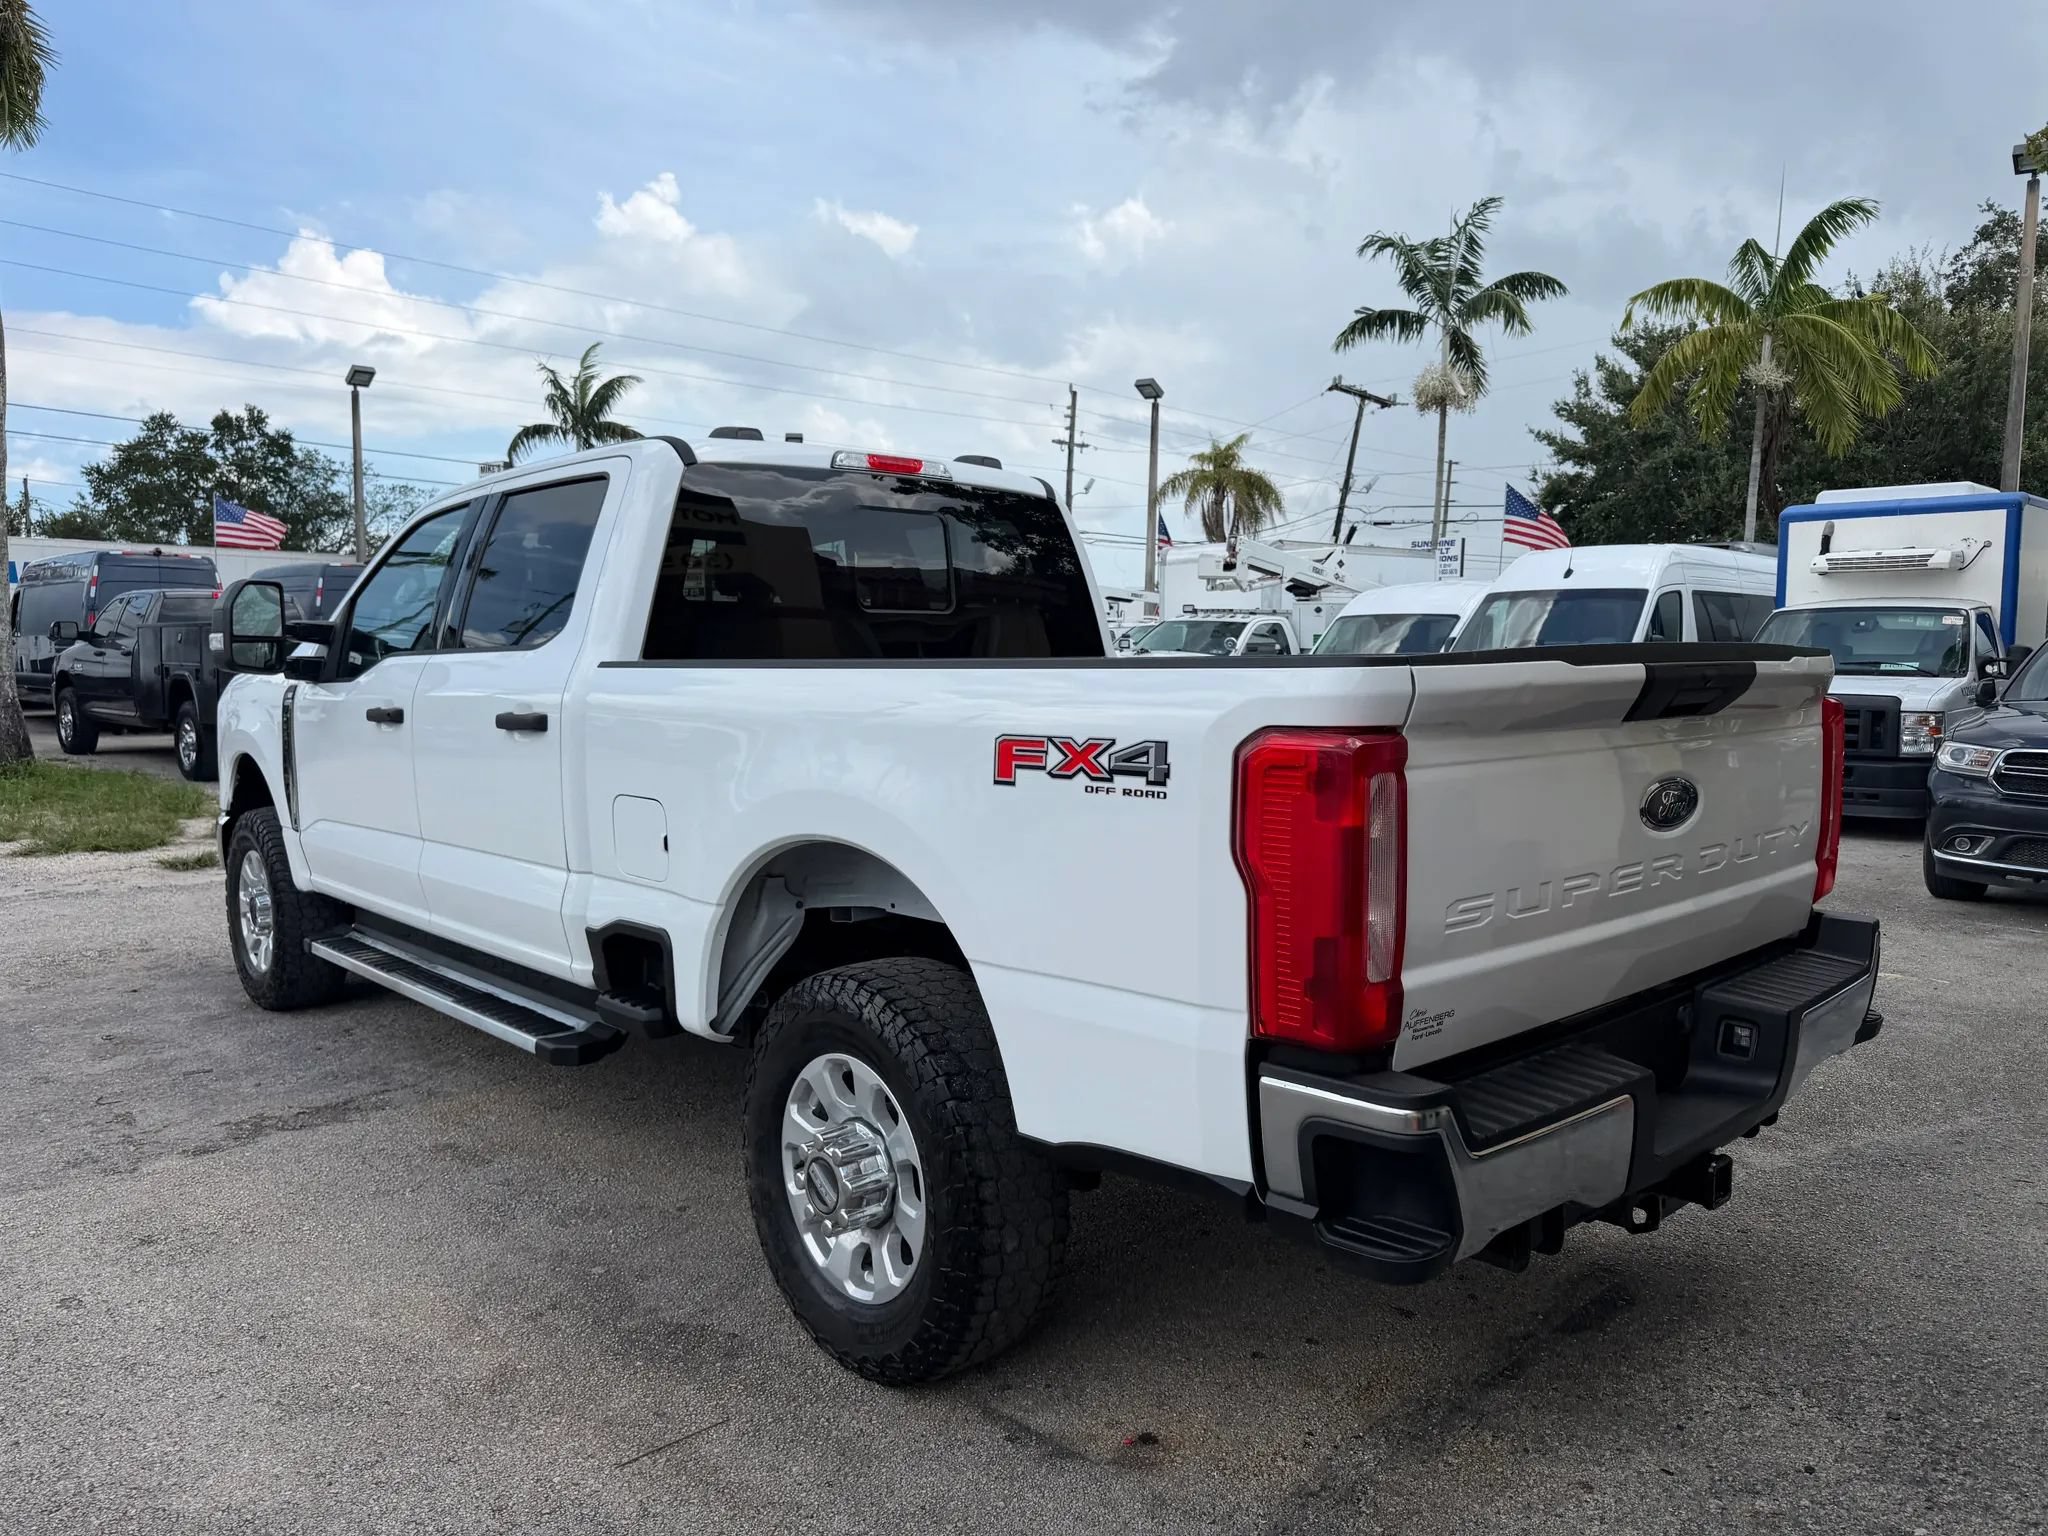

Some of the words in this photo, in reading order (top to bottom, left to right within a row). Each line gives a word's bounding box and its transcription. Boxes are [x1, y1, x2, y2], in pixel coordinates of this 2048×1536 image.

[1411, 540, 1456, 548] SUNINE
[993, 734, 1170, 787] FX4
[1084, 785, 1116, 795] OFF
[1122, 788, 1167, 800] ROAD
[1445, 853, 1684, 935] SUPER
[1698, 821, 1809, 874] DUTY
[1403, 1009, 1455, 1031] AUFFENBERG
